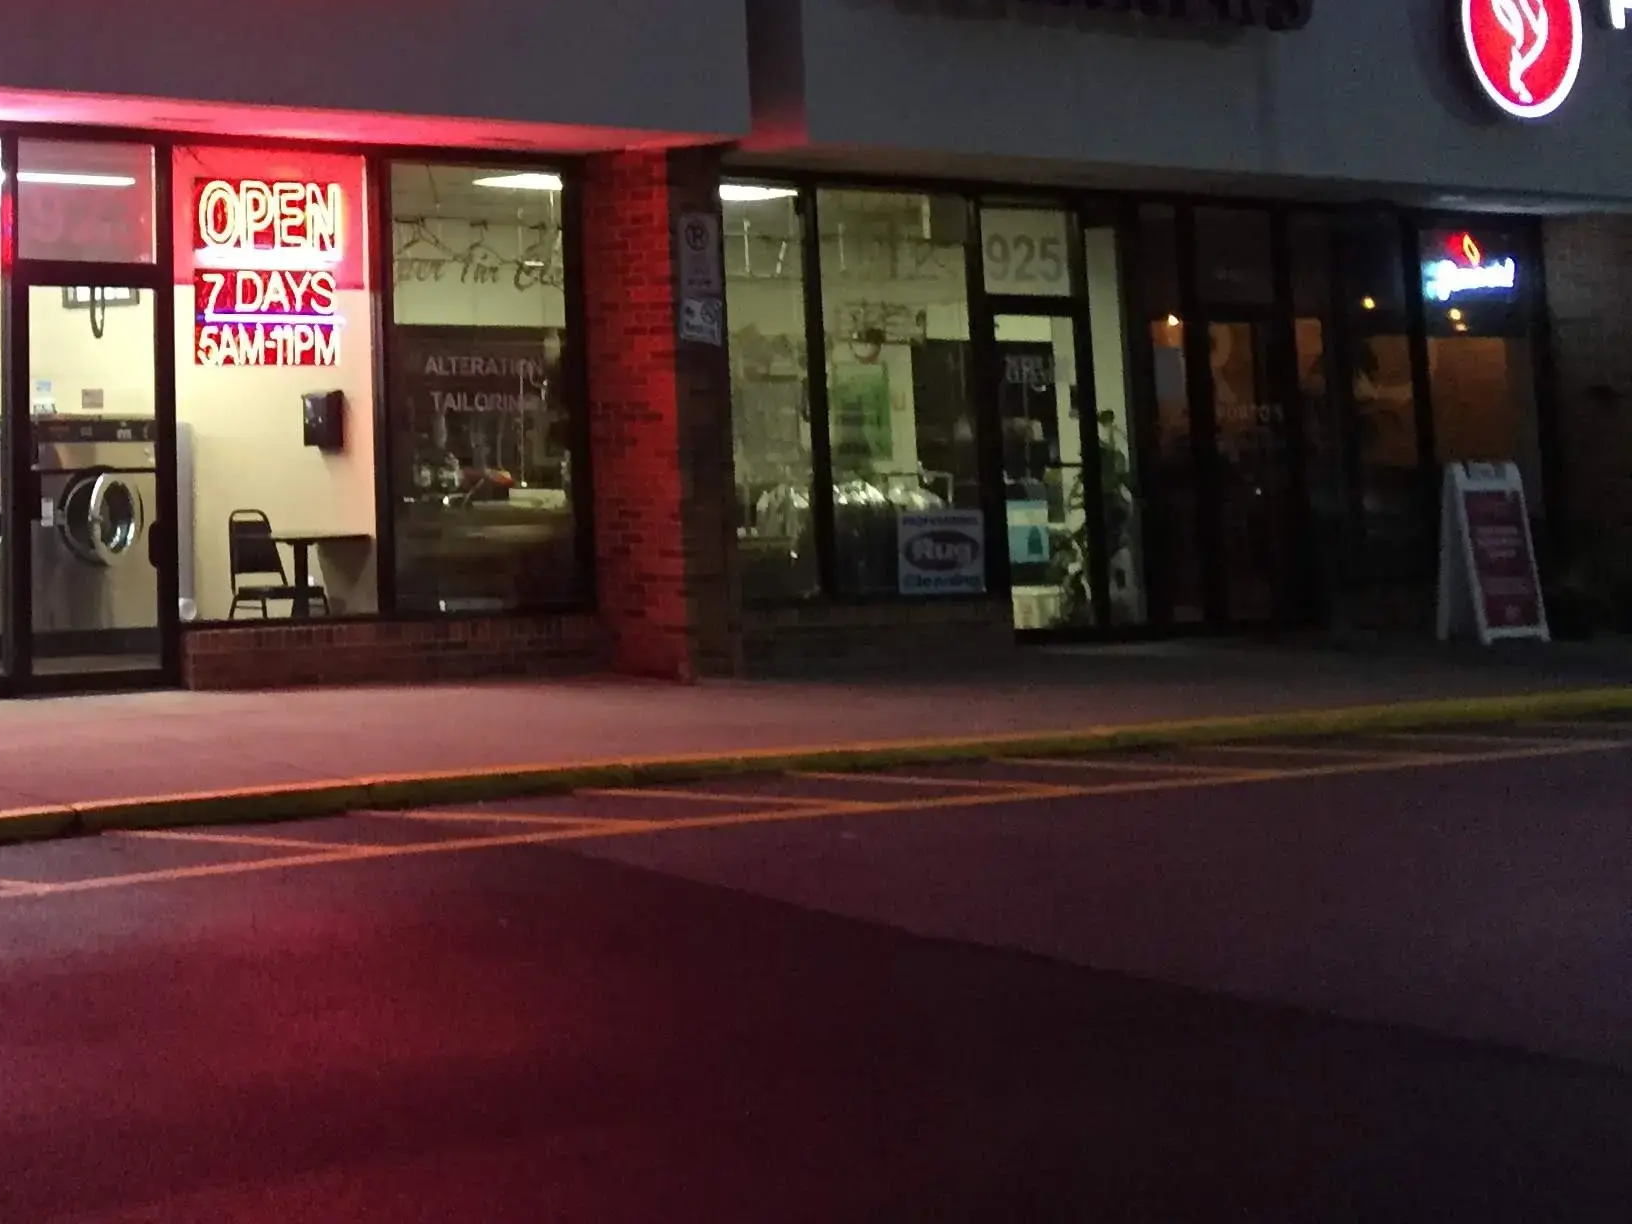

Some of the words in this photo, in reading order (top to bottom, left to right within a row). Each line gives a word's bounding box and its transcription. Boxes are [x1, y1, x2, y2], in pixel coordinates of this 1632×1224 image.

[199, 180, 343, 253] OPEN
[984, 232, 1063, 283] 925
[202, 273, 225, 319] 7
[235, 270, 339, 315] DAYS
[197, 323, 342, 368] 5AM-11PM
[911, 536, 973, 566] Rug
